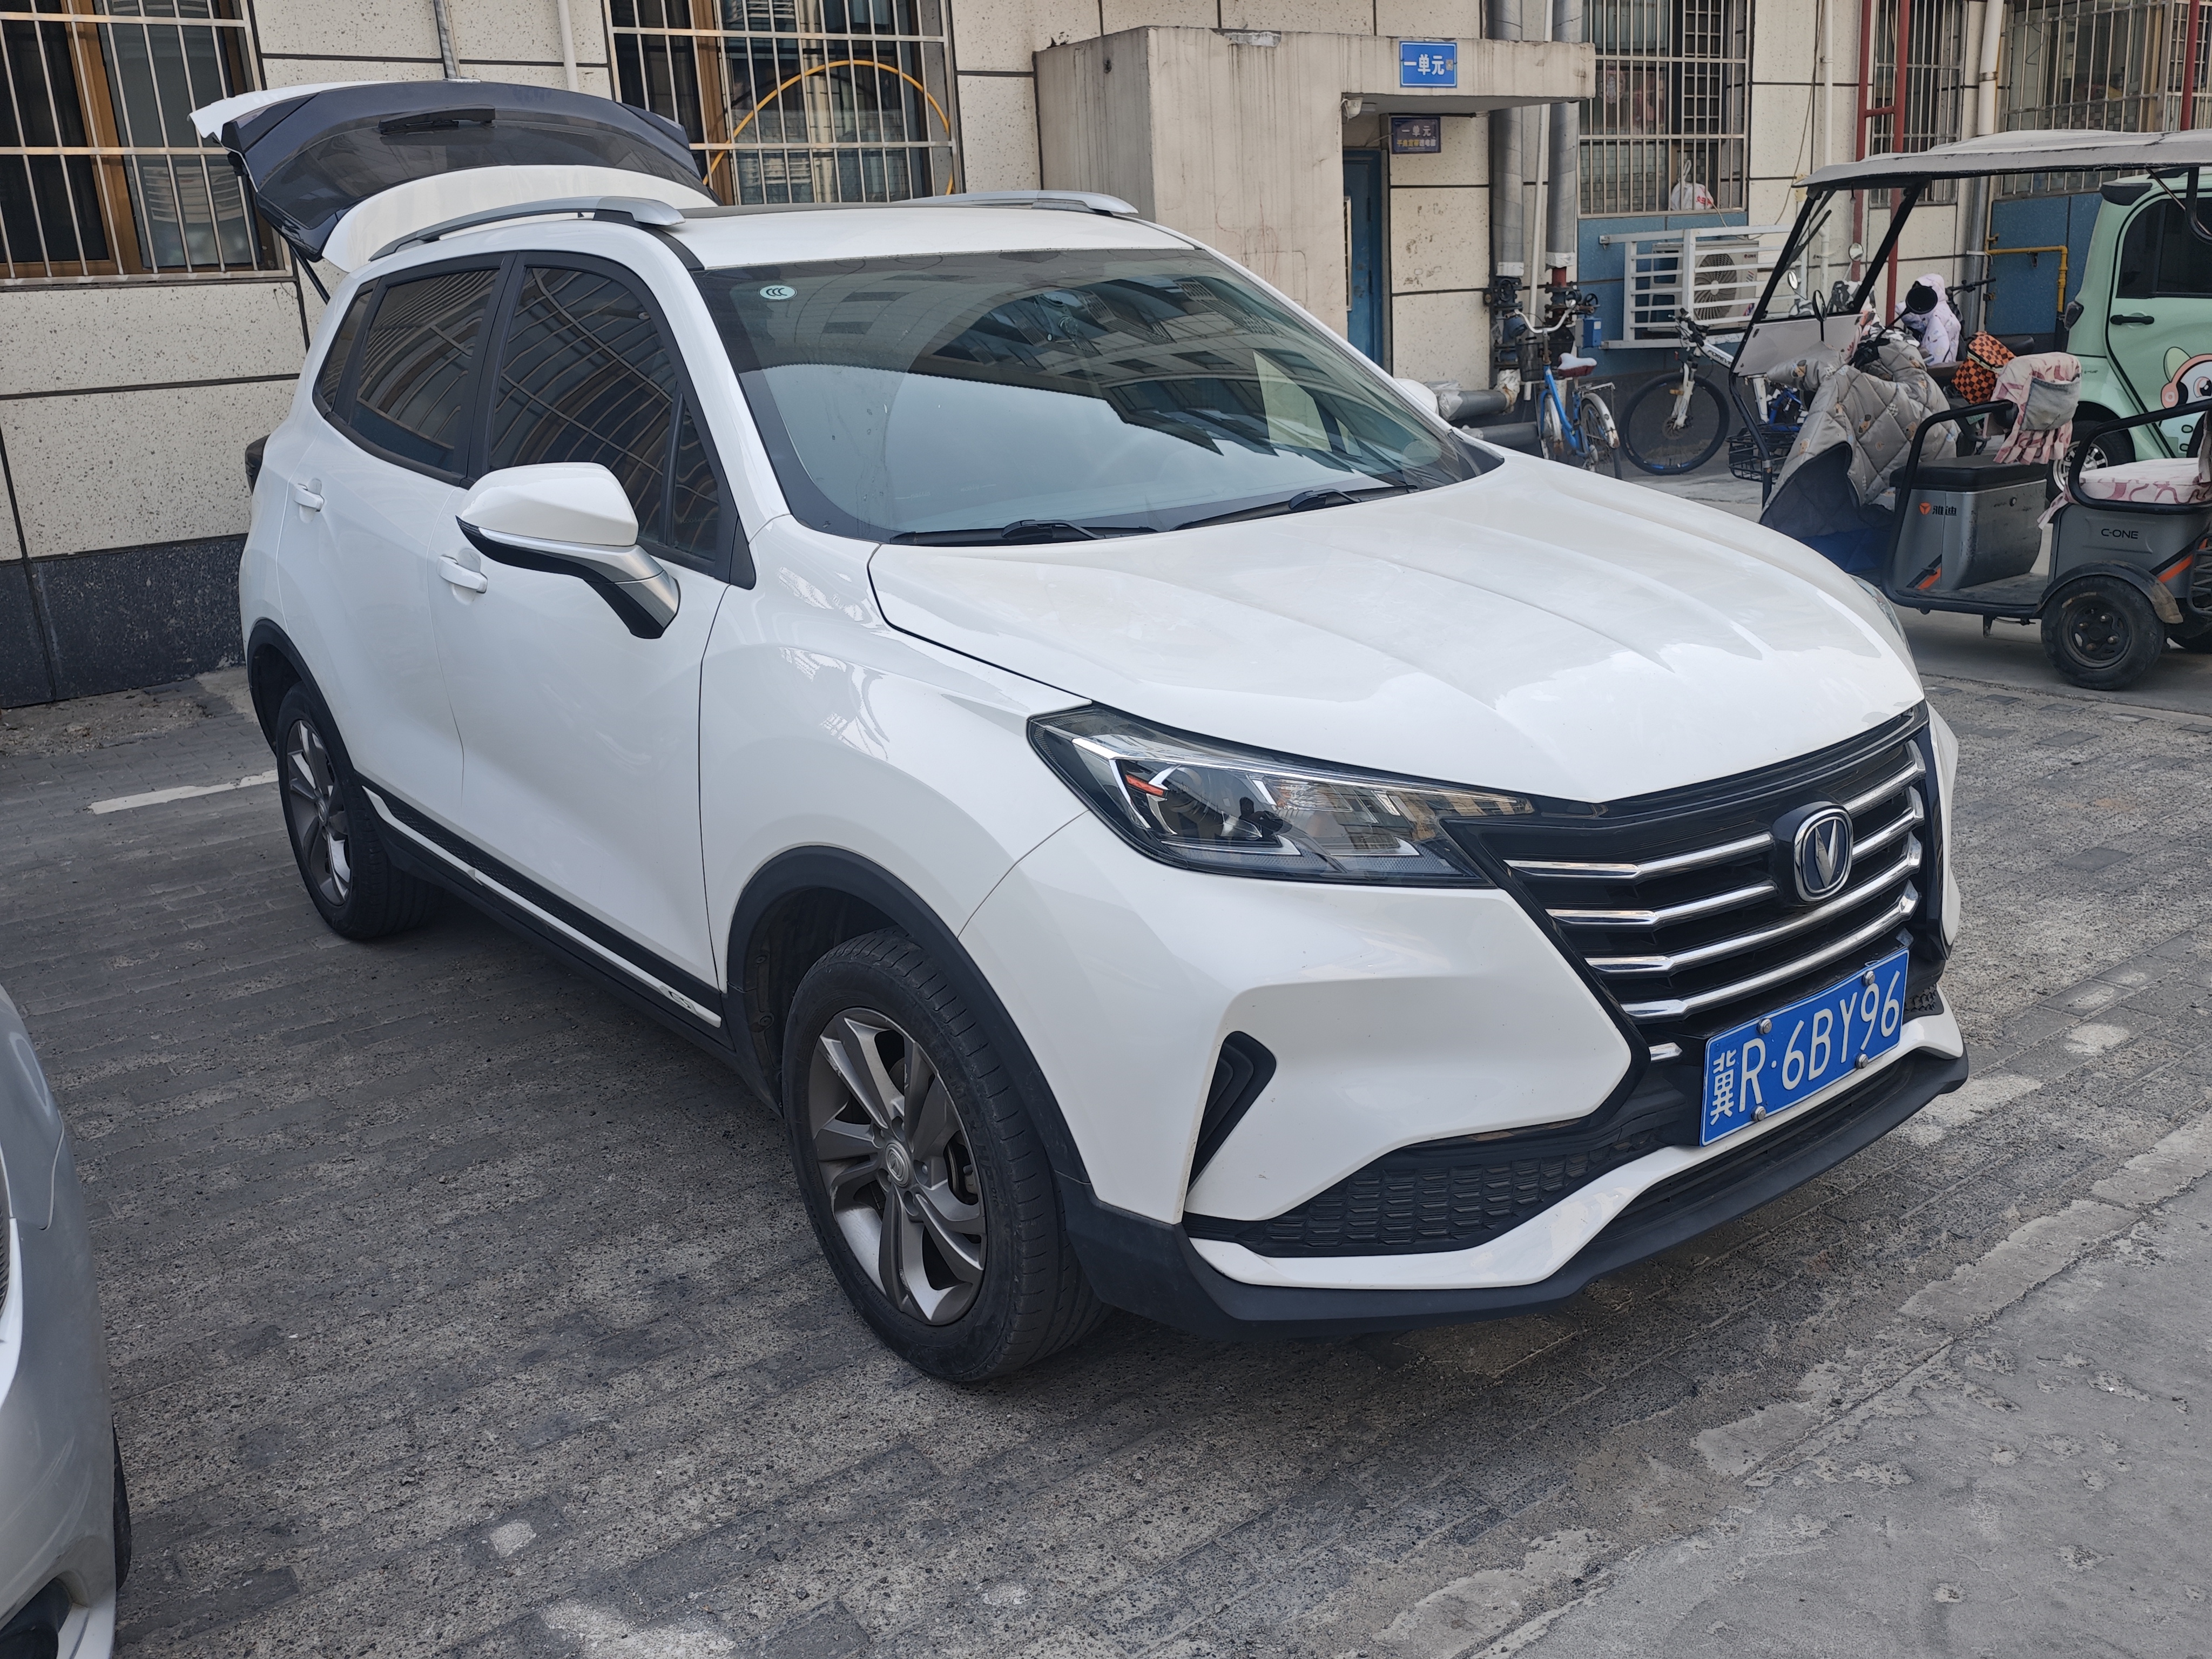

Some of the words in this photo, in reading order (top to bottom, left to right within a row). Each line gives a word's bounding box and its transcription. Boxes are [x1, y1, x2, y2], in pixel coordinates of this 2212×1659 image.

[1404, 53, 1445, 76] 一单元
[1401, 125, 1432, 137] 一单元
[1932, 505, 1957, 516] 雅迪
[2101, 528, 2139, 539] C-ONE
[1709, 970, 1901, 1126] 冀R·6BY96
